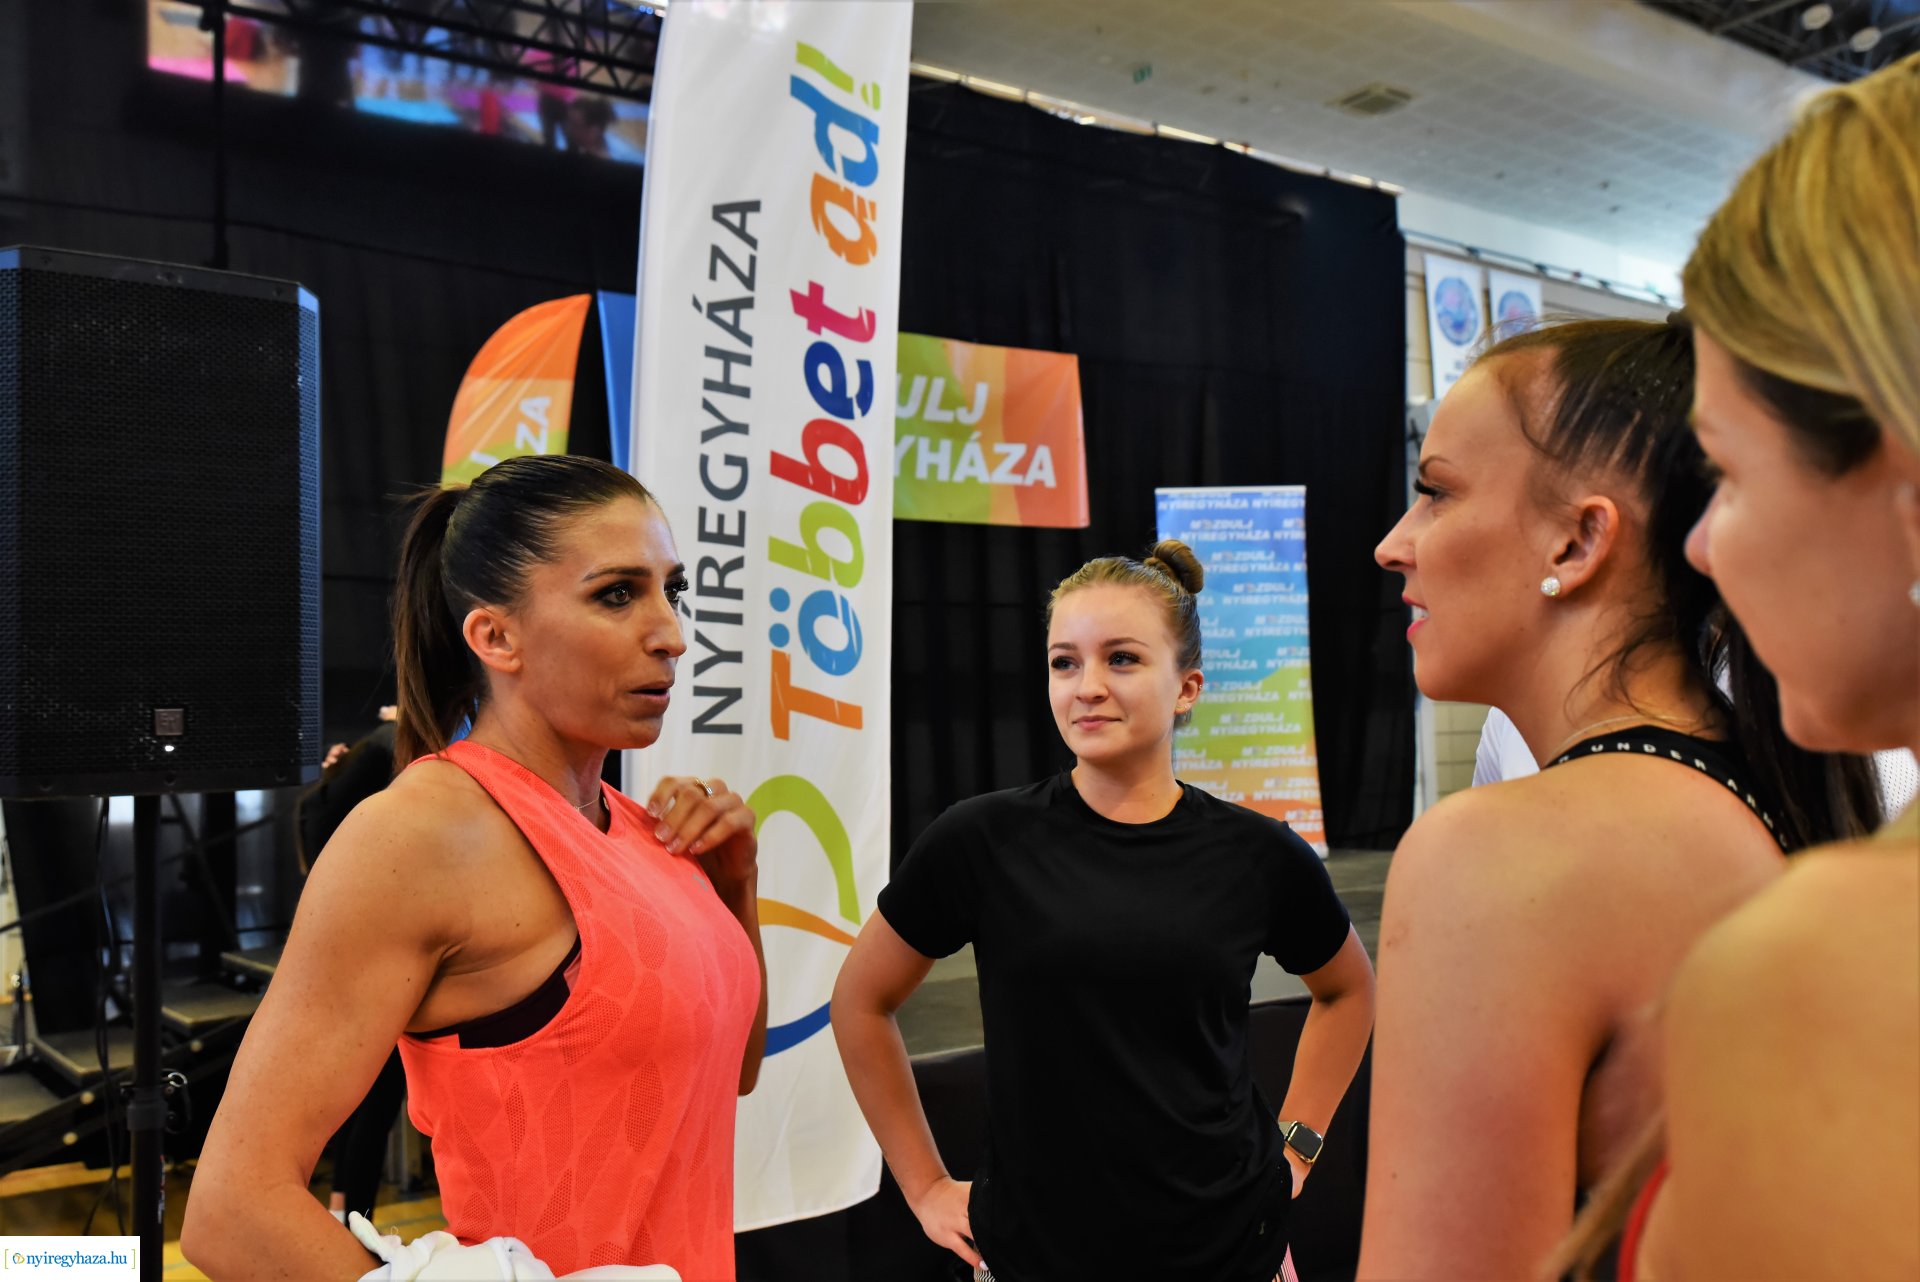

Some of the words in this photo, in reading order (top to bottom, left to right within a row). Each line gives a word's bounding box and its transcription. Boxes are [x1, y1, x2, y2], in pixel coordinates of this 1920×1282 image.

[791, 41, 880, 265] ad!
[680, 200, 761, 735] NYÍREGYHÁZA
[768, 280, 876, 741] Többet
[1591, 743, 1706, 770] UNDER
